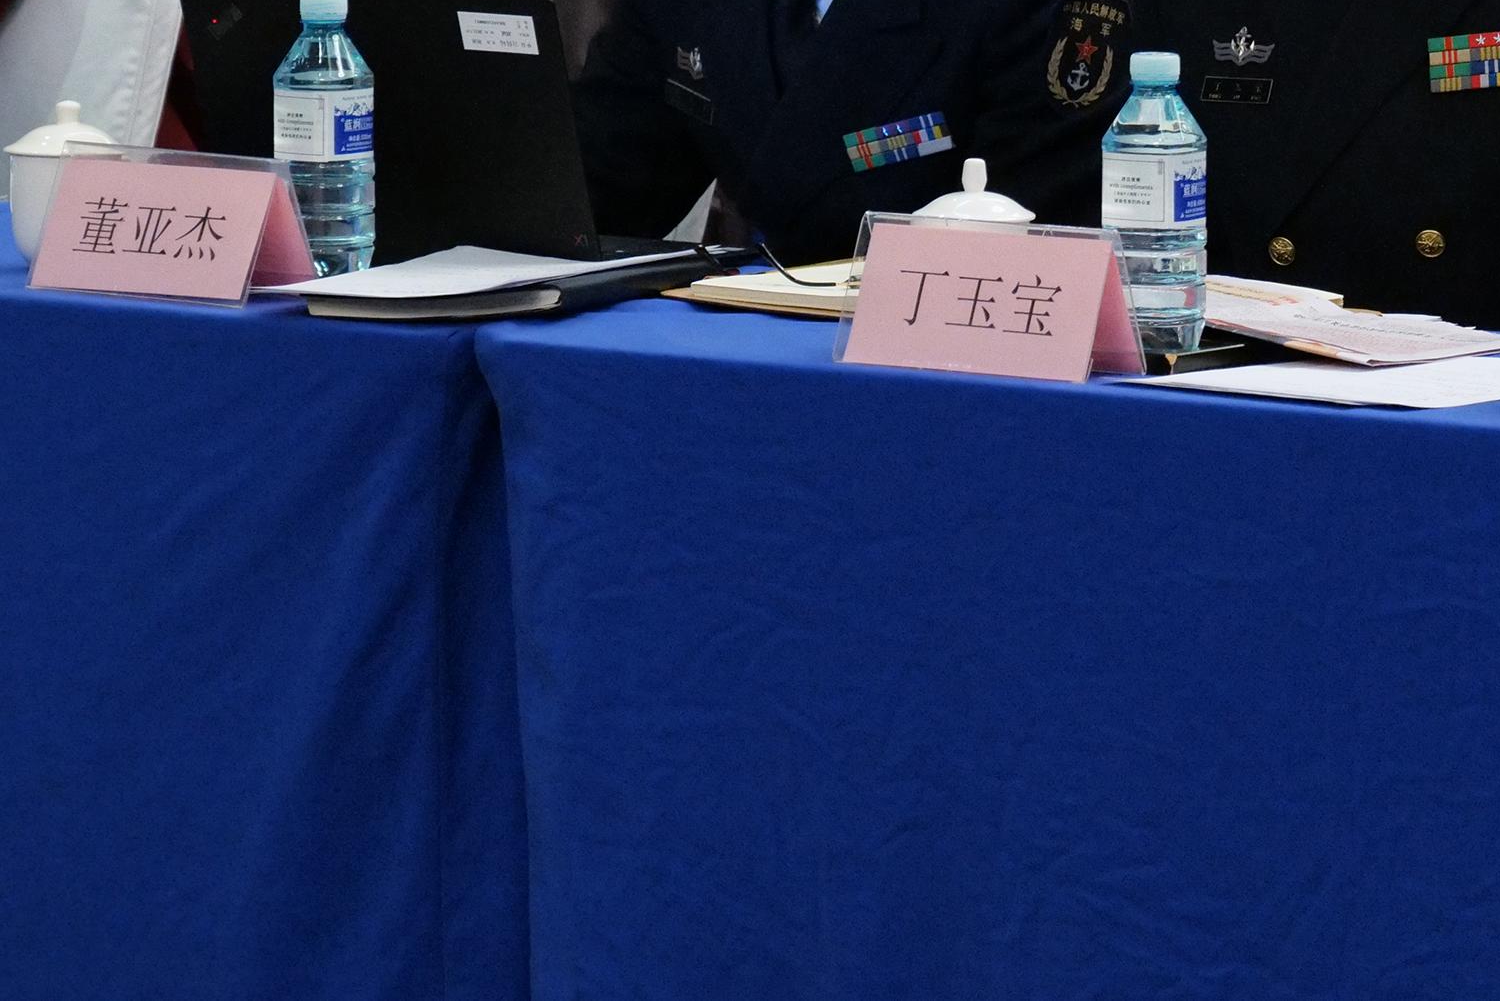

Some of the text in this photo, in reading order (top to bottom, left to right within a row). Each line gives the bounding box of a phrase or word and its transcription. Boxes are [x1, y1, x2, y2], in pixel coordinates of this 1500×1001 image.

[72, 196, 227, 261] 董亚杰
[901, 270, 1062, 337] 丁玉宝
